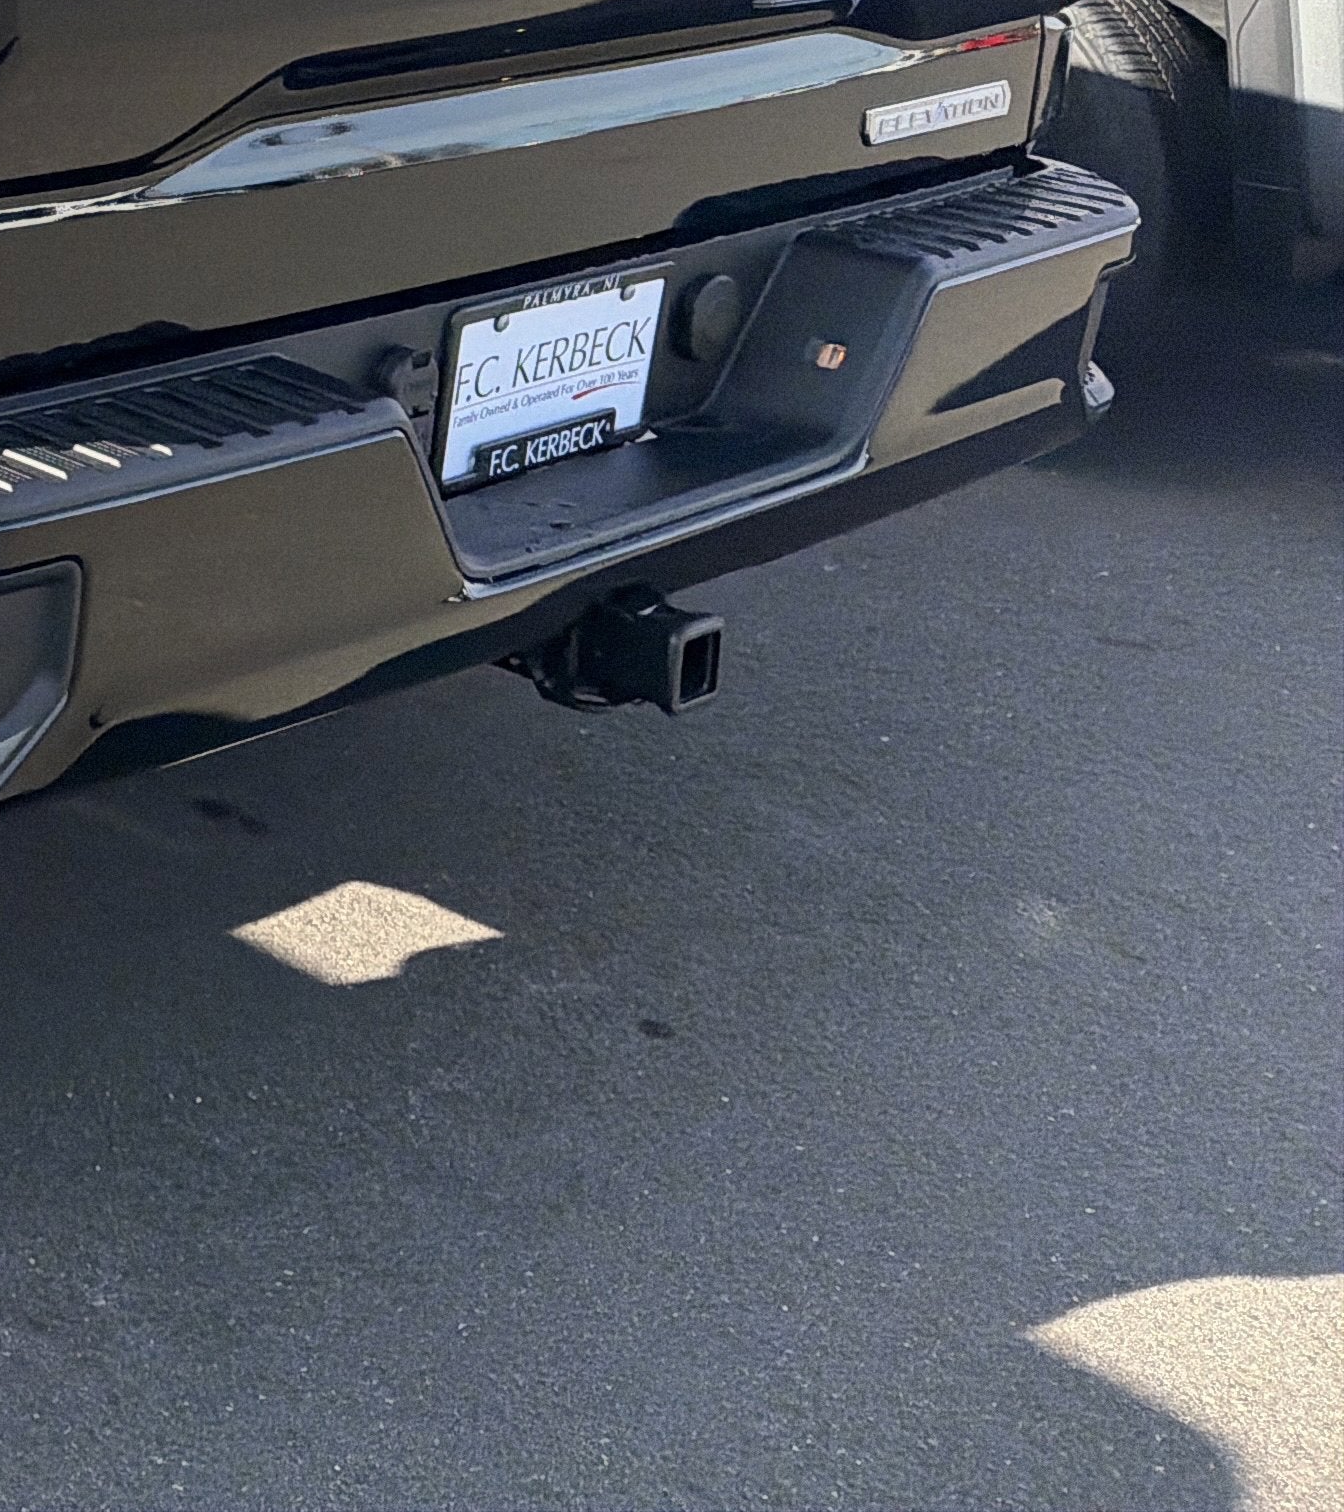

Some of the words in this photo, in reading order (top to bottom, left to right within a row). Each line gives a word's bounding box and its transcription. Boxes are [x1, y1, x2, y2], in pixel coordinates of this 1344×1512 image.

[878, 92, 1000, 136] ELEVATION
[454, 355, 500, 406] F.C.
[512, 316, 652, 388] KERBECK
[452, 412, 479, 429] Family
[480, 402, 510, 420] Owned
[512, 399, 519, 410] &
[520, 387, 560, 408] Operated
[560, 383, 575, 396] For
[576, 377, 597, 392] Over
[598, 371, 615, 386] 100
[617, 368, 640, 381] Years
[489, 445, 519, 477] F.C.
[524, 418, 605, 467] KERBECK
